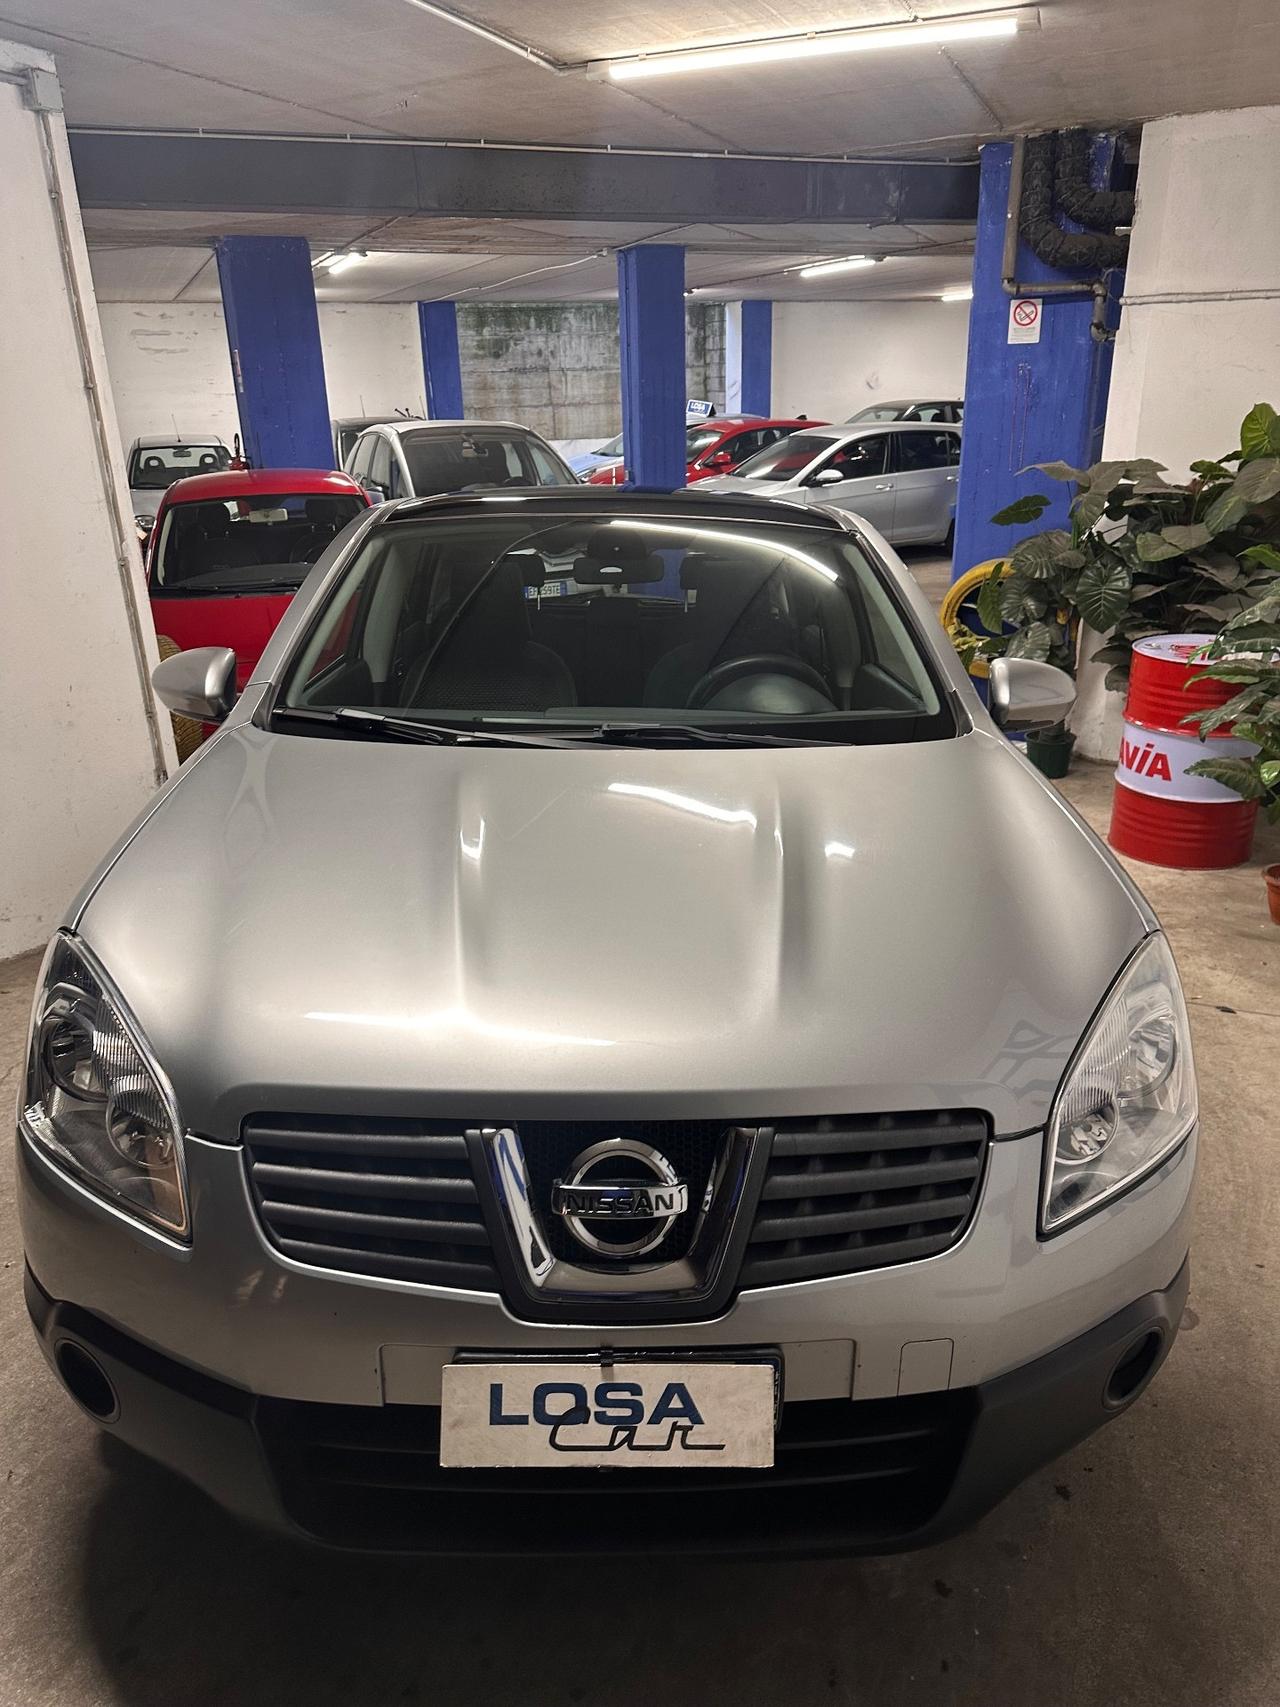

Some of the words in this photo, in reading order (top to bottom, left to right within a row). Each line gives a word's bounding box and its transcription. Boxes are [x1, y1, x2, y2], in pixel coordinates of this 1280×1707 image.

[564, 1194, 674, 1214] NISSAN
[489, 1382, 705, 1426] LOSA
[549, 1404, 726, 1451] Car
